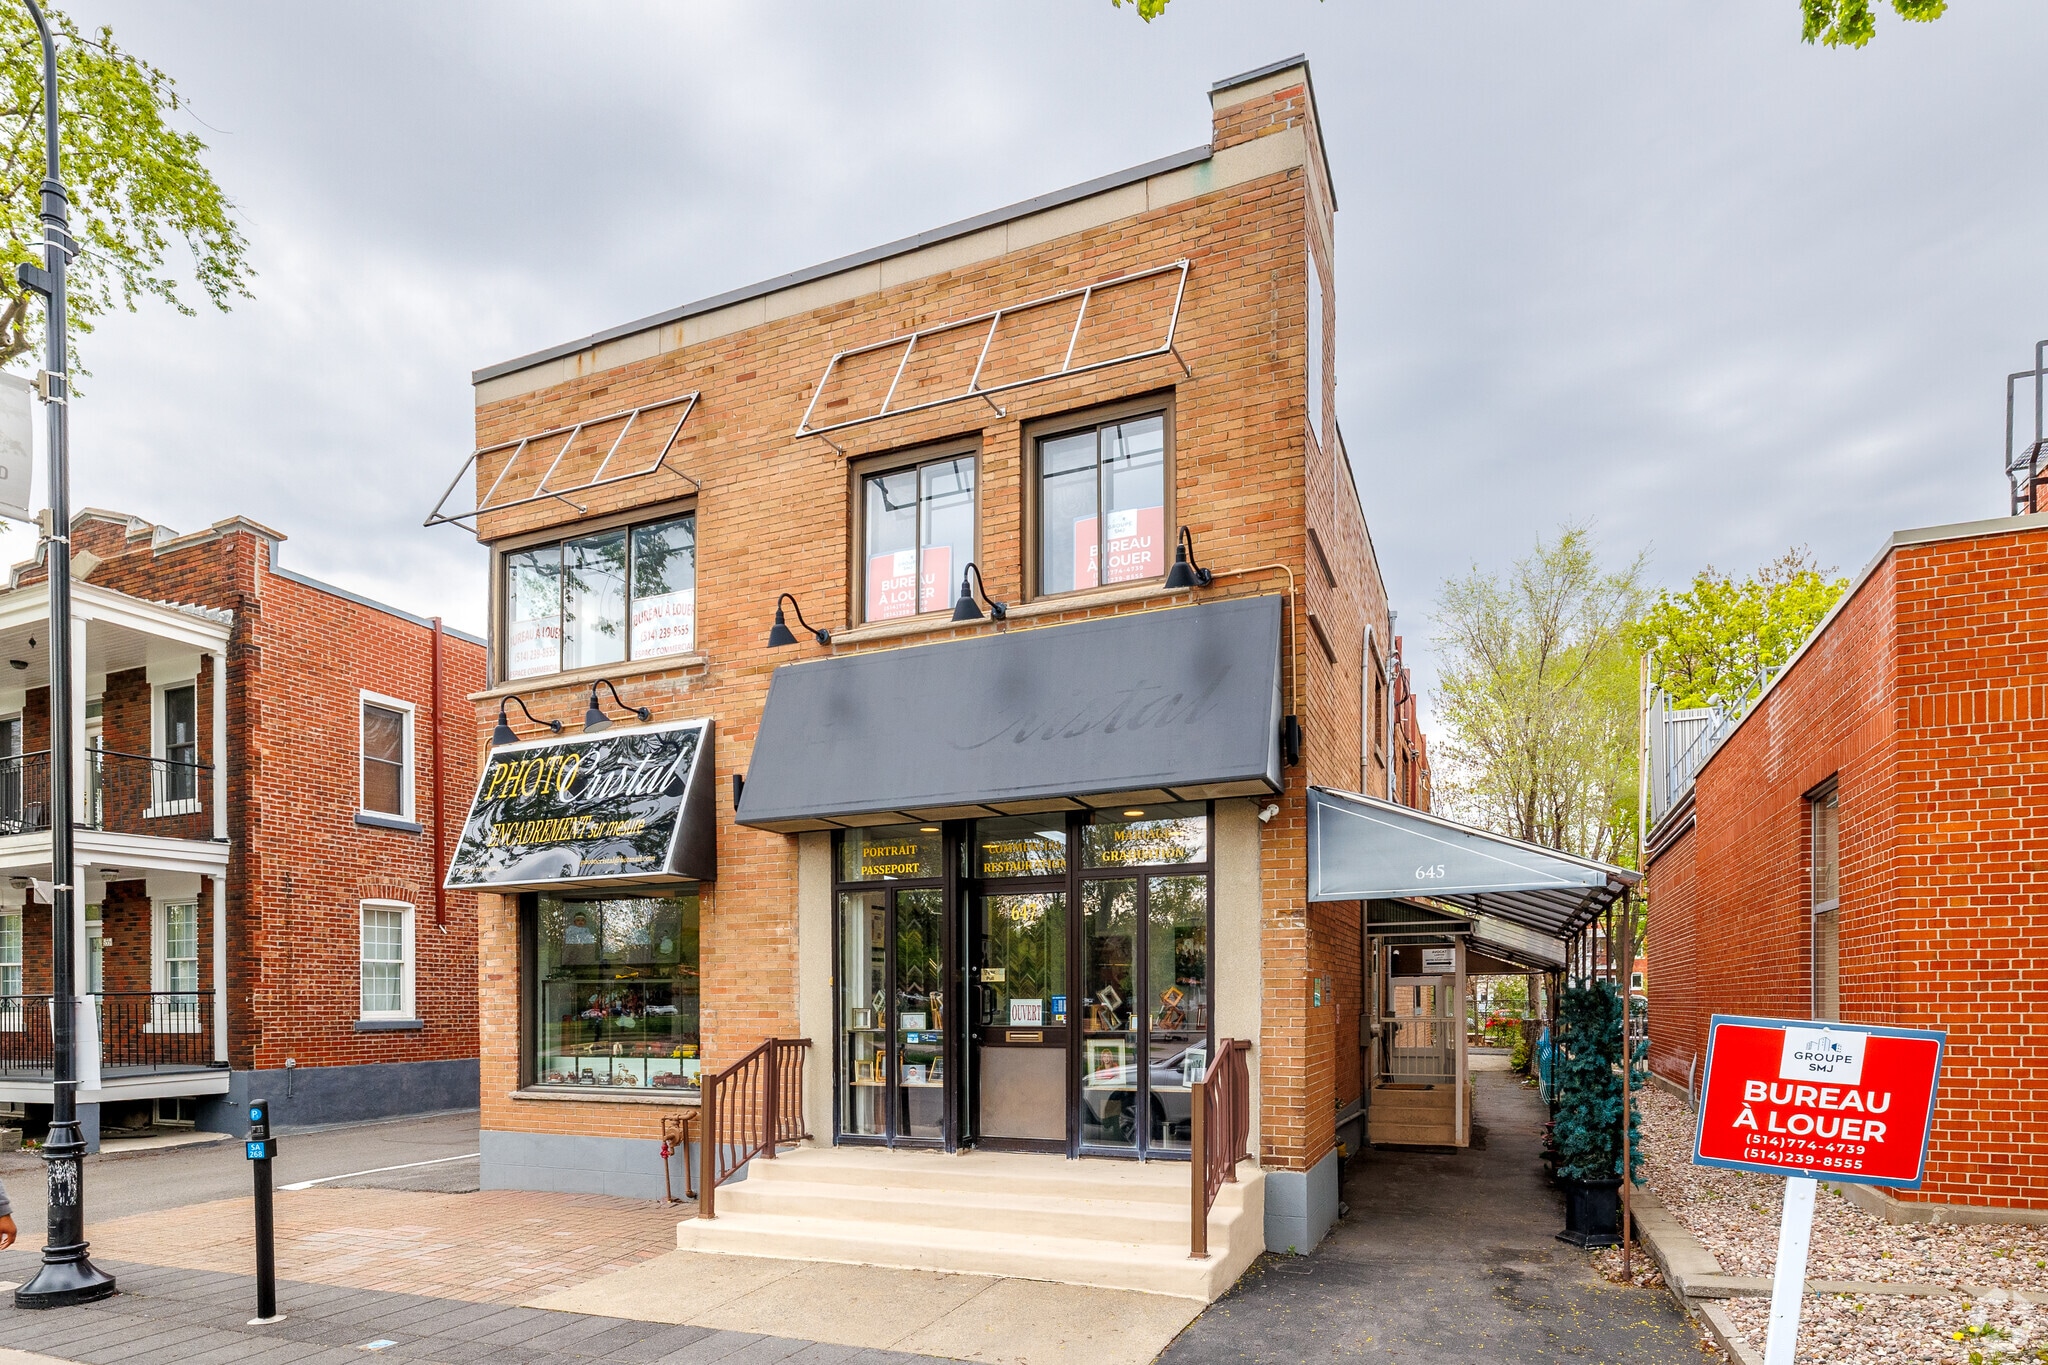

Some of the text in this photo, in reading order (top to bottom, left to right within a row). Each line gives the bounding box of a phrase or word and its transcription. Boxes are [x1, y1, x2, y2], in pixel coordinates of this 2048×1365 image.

[1090, 535, 1151, 557] BREAU
[1087, 551, 1151, 572] À OUER
[879, 591, 888, 606] À
[633, 605, 663, 627] BUREAU
[665, 601, 670, 616] À
[641, 624, 690, 642] (514) 239-8555
[514, 651, 529, 664] (514)
[635, 642, 693, 658] ESPACE COMMERCIAL
[484, 746, 688, 803] PHOTO Cristal
[488, 815, 646, 848] ENCADREMENT sur mesure
[1114, 828, 1172, 841] MARIAGE
[862, 844, 918, 858] PORTRAIT
[1102, 846, 1185, 862] GRADUATION
[860, 862, 920, 876] PASSEPORT
[983, 858, 1067, 873] RESTAURATION
[1415, 864, 1446, 880] 645
[1011, 903, 1037, 920] 647
[1012, 1004, 1041, 1021] OUVERT
[1794, 1051, 1853, 1064] GROUPE
[1808, 1063, 1834, 1073] SMJ
[1743, 1079, 1891, 1114] BUREAU
[1732, 1102, 1887, 1143] À LOUER
[1746, 1132, 1866, 1155] (514)774-4739
[1744, 1146, 1863, 1170] (514)239-8555
